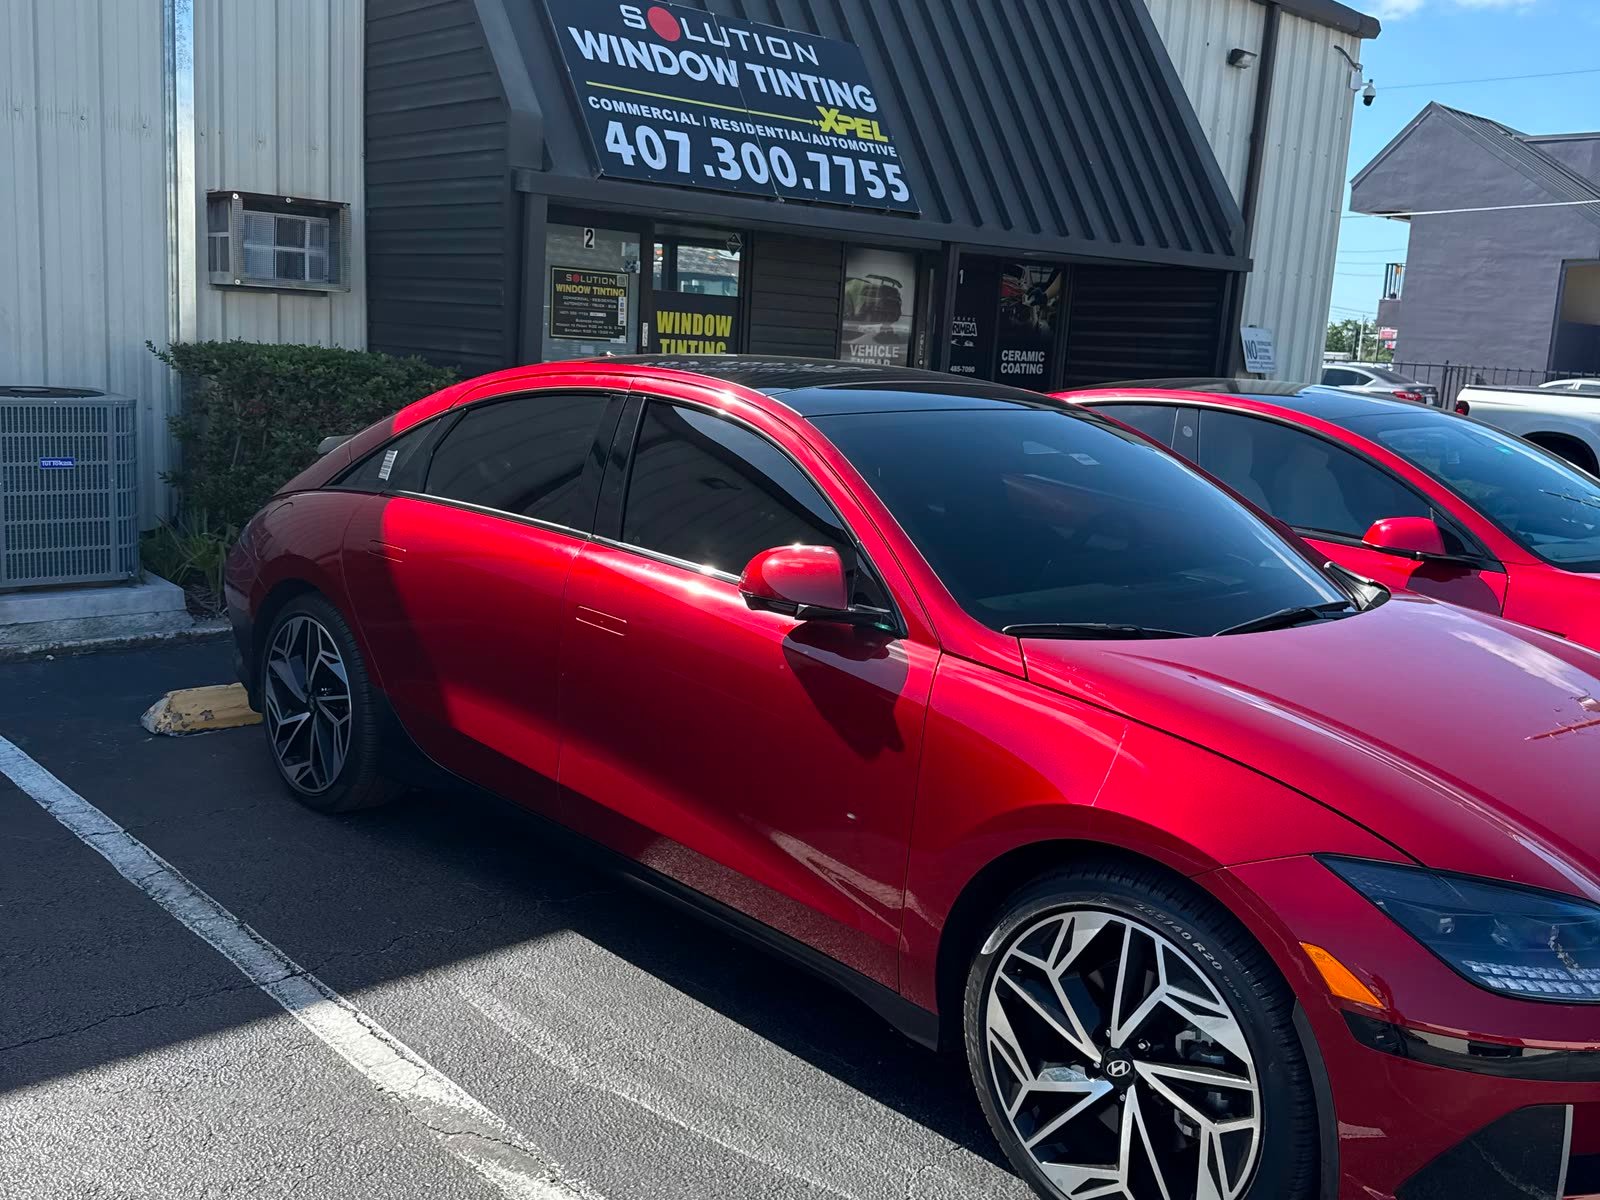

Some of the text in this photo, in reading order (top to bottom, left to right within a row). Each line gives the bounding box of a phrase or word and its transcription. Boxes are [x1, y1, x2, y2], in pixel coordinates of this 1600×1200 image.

[620, 4, 820, 66] SOLUTION
[568, 26, 877, 114] WINDOW TINTING
[588, 96, 700, 126] COMMERCIAL
[816, 105, 888, 142] XPEL
[605, 120, 910, 202] 407.300.7755
[585, 228, 594, 248] 2
[566, 273, 616, 285] SOLUTION
[959, 269, 964, 284] 1
[556, 284, 625, 296] WINDOW TINTING
[656, 310, 732, 337] WINDOW
[660, 338, 726, 354] TINTING
[850, 344, 899, 358] VEHICLE
[1001, 350, 1045, 362] CERAMIC
[1244, 340, 1257, 360] NO
[1000, 362, 1043, 374] COATING
[1192, 942, 1223, 971] R20
